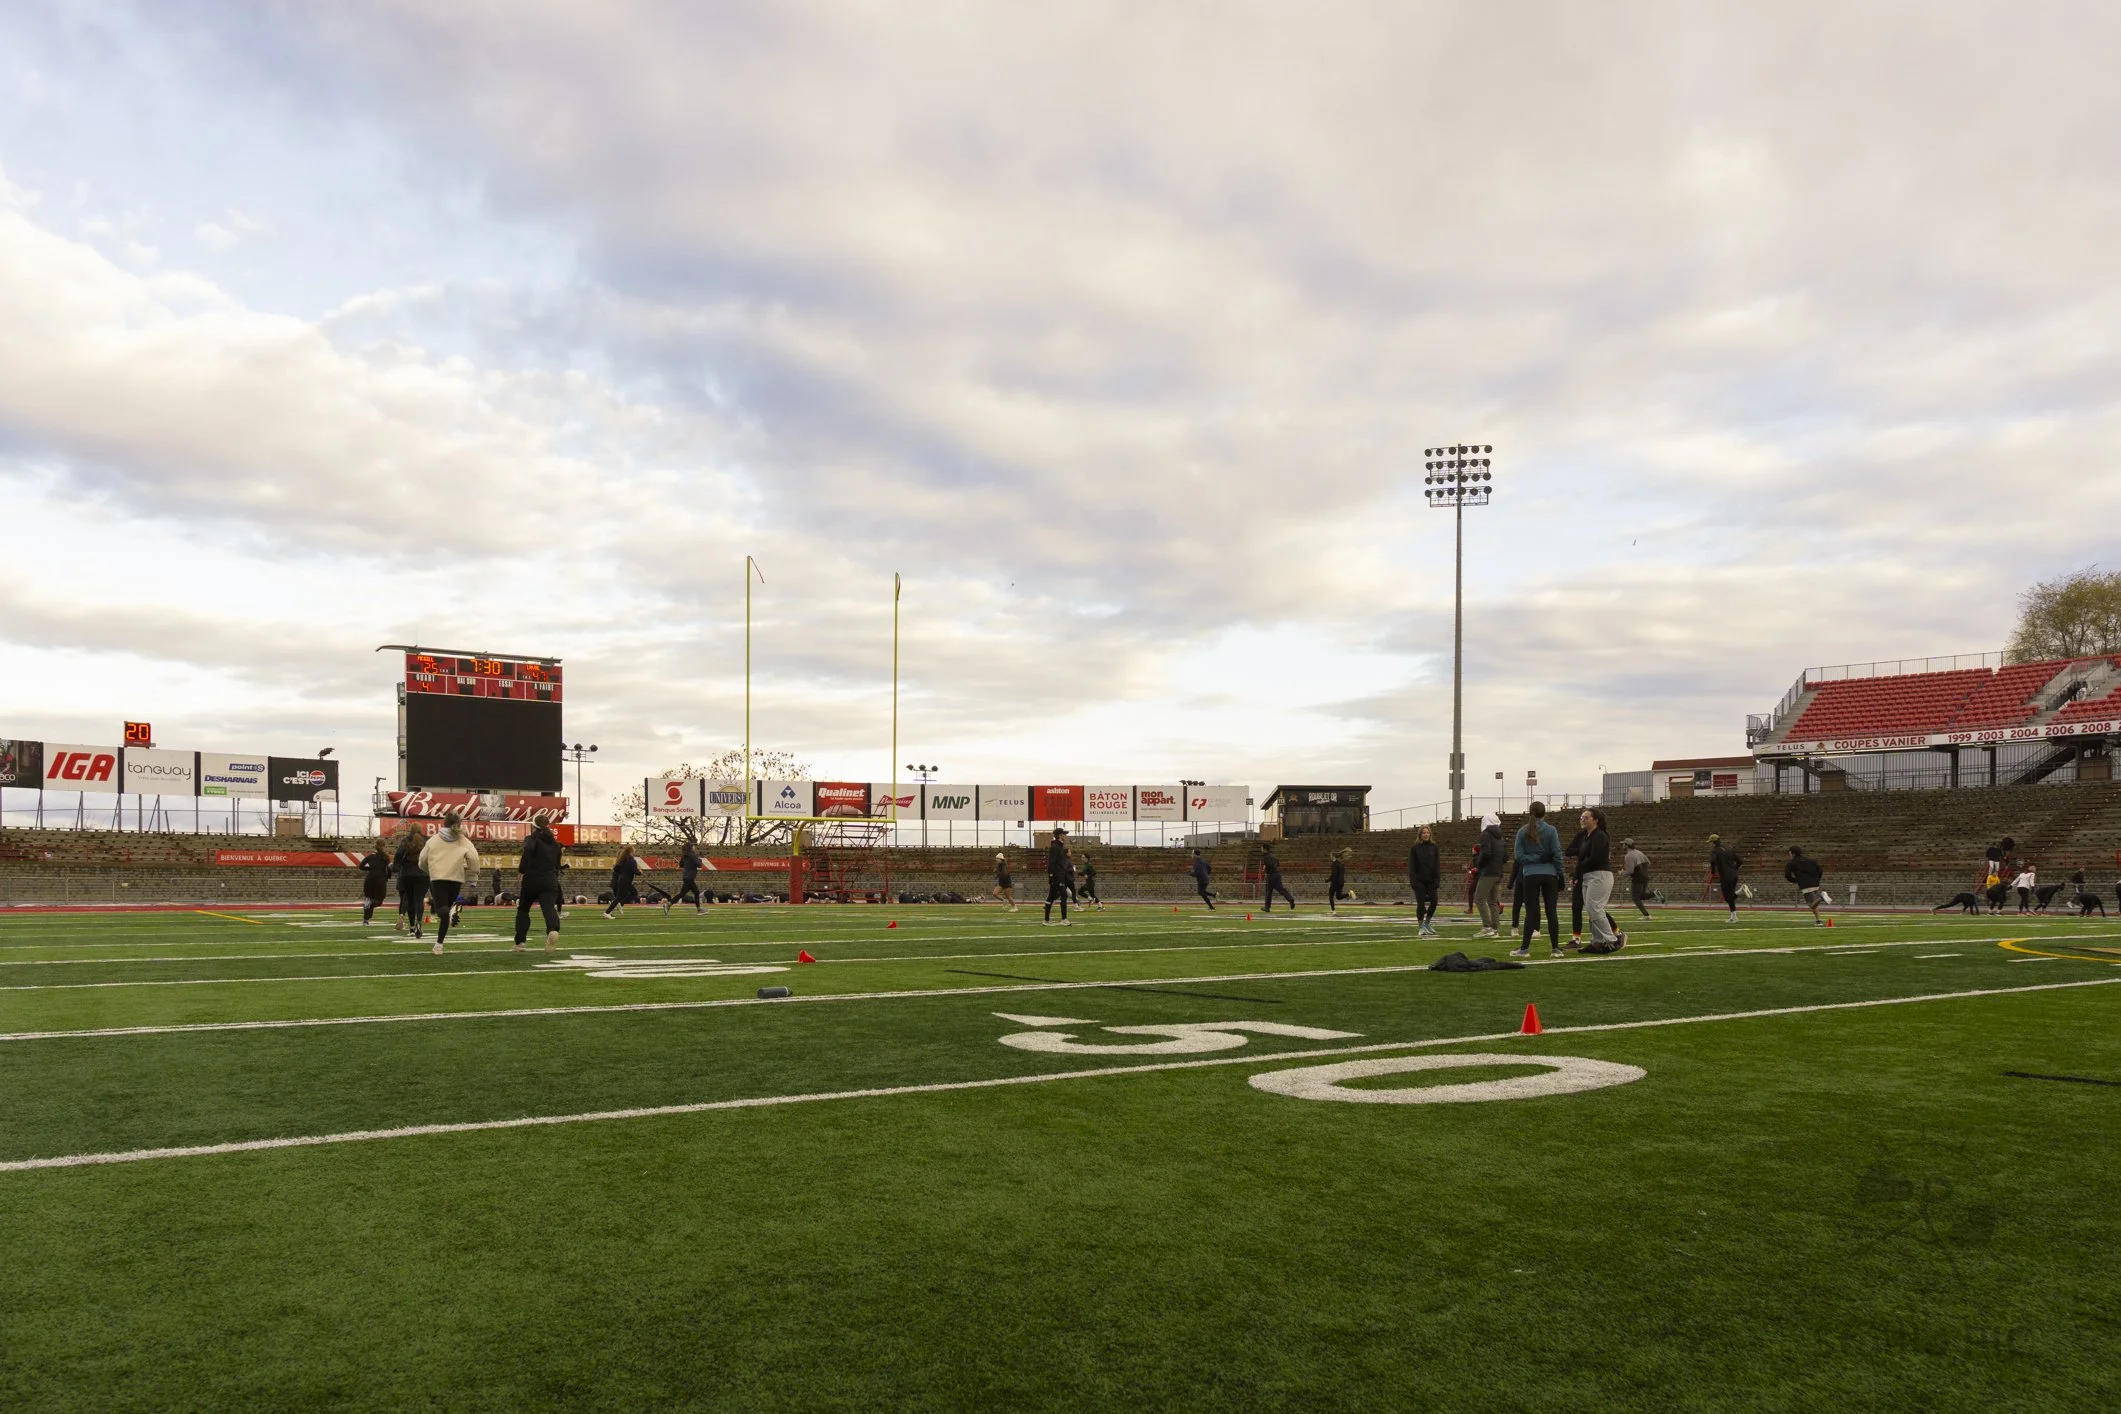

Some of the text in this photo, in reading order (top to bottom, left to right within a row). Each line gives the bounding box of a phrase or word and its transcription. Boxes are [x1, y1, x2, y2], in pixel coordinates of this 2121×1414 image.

[424, 663, 438, 674] 25
[471, 660, 500, 675] 7:30
[532, 672, 548, 682] 47
[422, 682, 430, 692] 4
[126, 723, 149, 740] 20
[1948, 722, 2111, 742] 1999 2003 2004 2006 2008
[1834, 736, 1926, 749] COUPES VANIER
[47, 752, 116, 781] IGA
[818, 787, 865, 798] Qualinet
[774, 801, 801, 809] Alcoa
[932, 796, 970, 809] MNP
[1141, 796, 1176, 806] appart.
